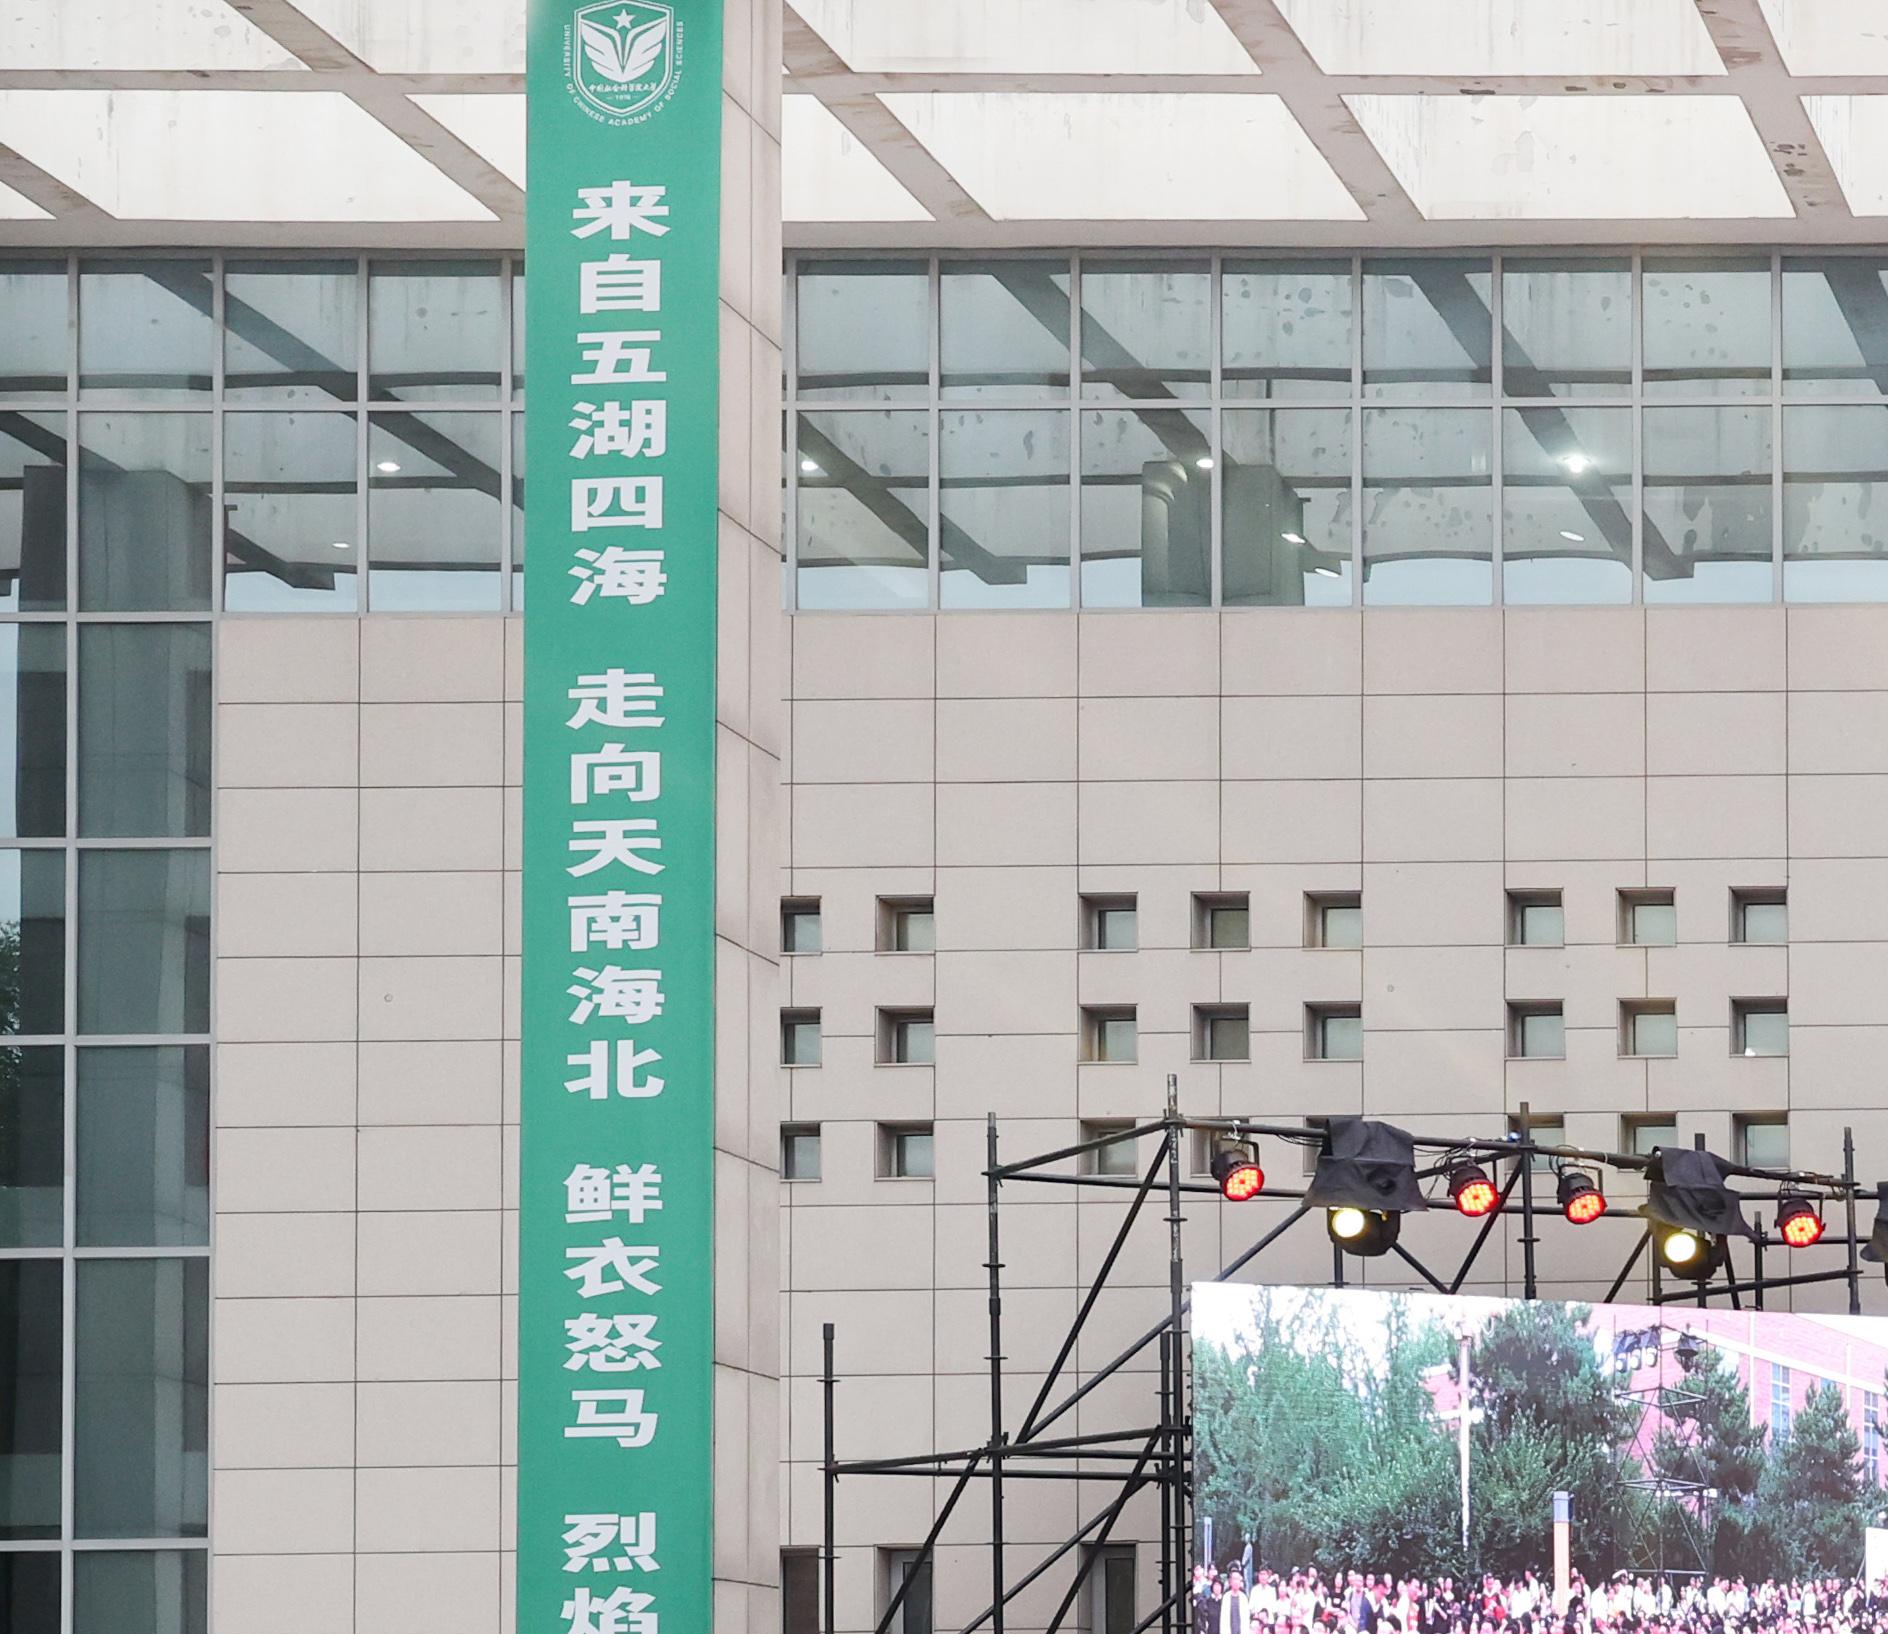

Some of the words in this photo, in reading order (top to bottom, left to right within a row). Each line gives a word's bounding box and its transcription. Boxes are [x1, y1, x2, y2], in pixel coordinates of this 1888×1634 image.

[569, 180, 671, 606] 来自五湖四海
[563, 667, 666, 1101] 走向天南海北
[562, 1163, 664, 1449] 鲜衣怒马
